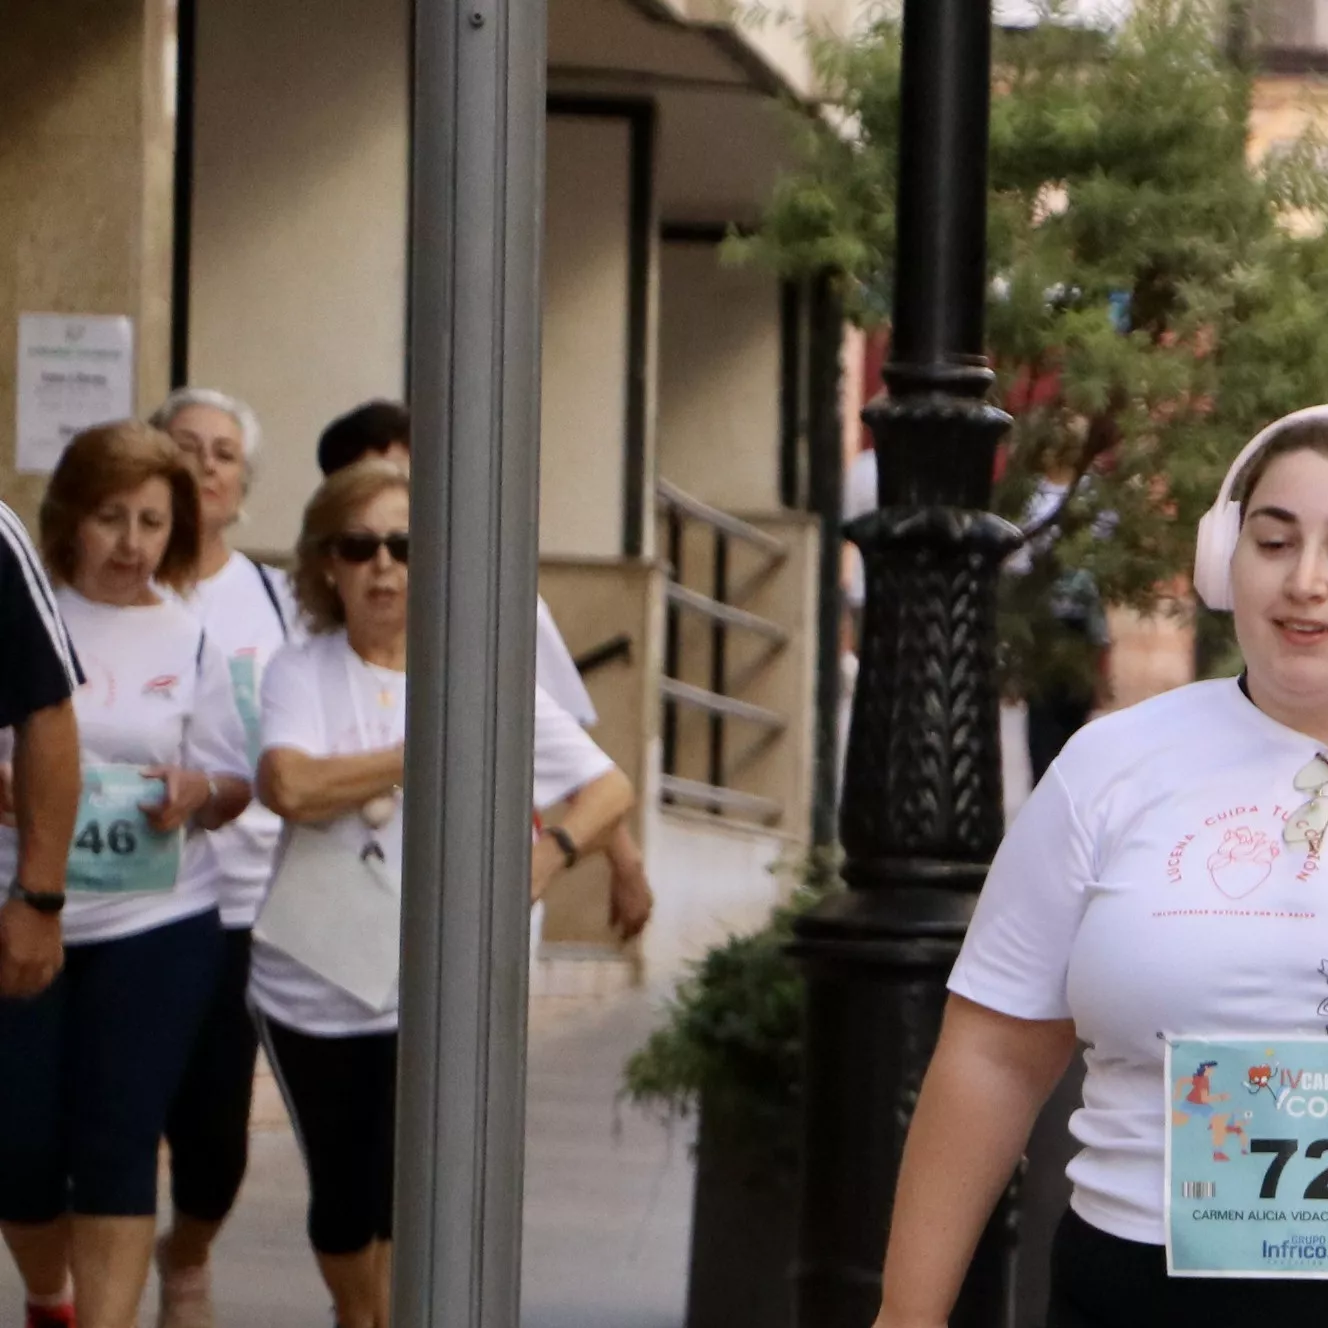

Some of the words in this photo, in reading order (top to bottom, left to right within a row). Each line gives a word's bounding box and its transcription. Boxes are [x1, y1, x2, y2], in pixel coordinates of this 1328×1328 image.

[75, 818, 137, 855] 46
[1167, 834, 1195, 884] LUCENA
[1204, 805, 1259, 826] CUIDA
[1280, 1068, 1303, 1089] IV
[1192, 1209, 1244, 1222] CARMEN
[1247, 1210, 1287, 1222] ALICIA
[1262, 1239, 1327, 1260] Infrico
[1291, 1234, 1326, 1245] GRUPO
